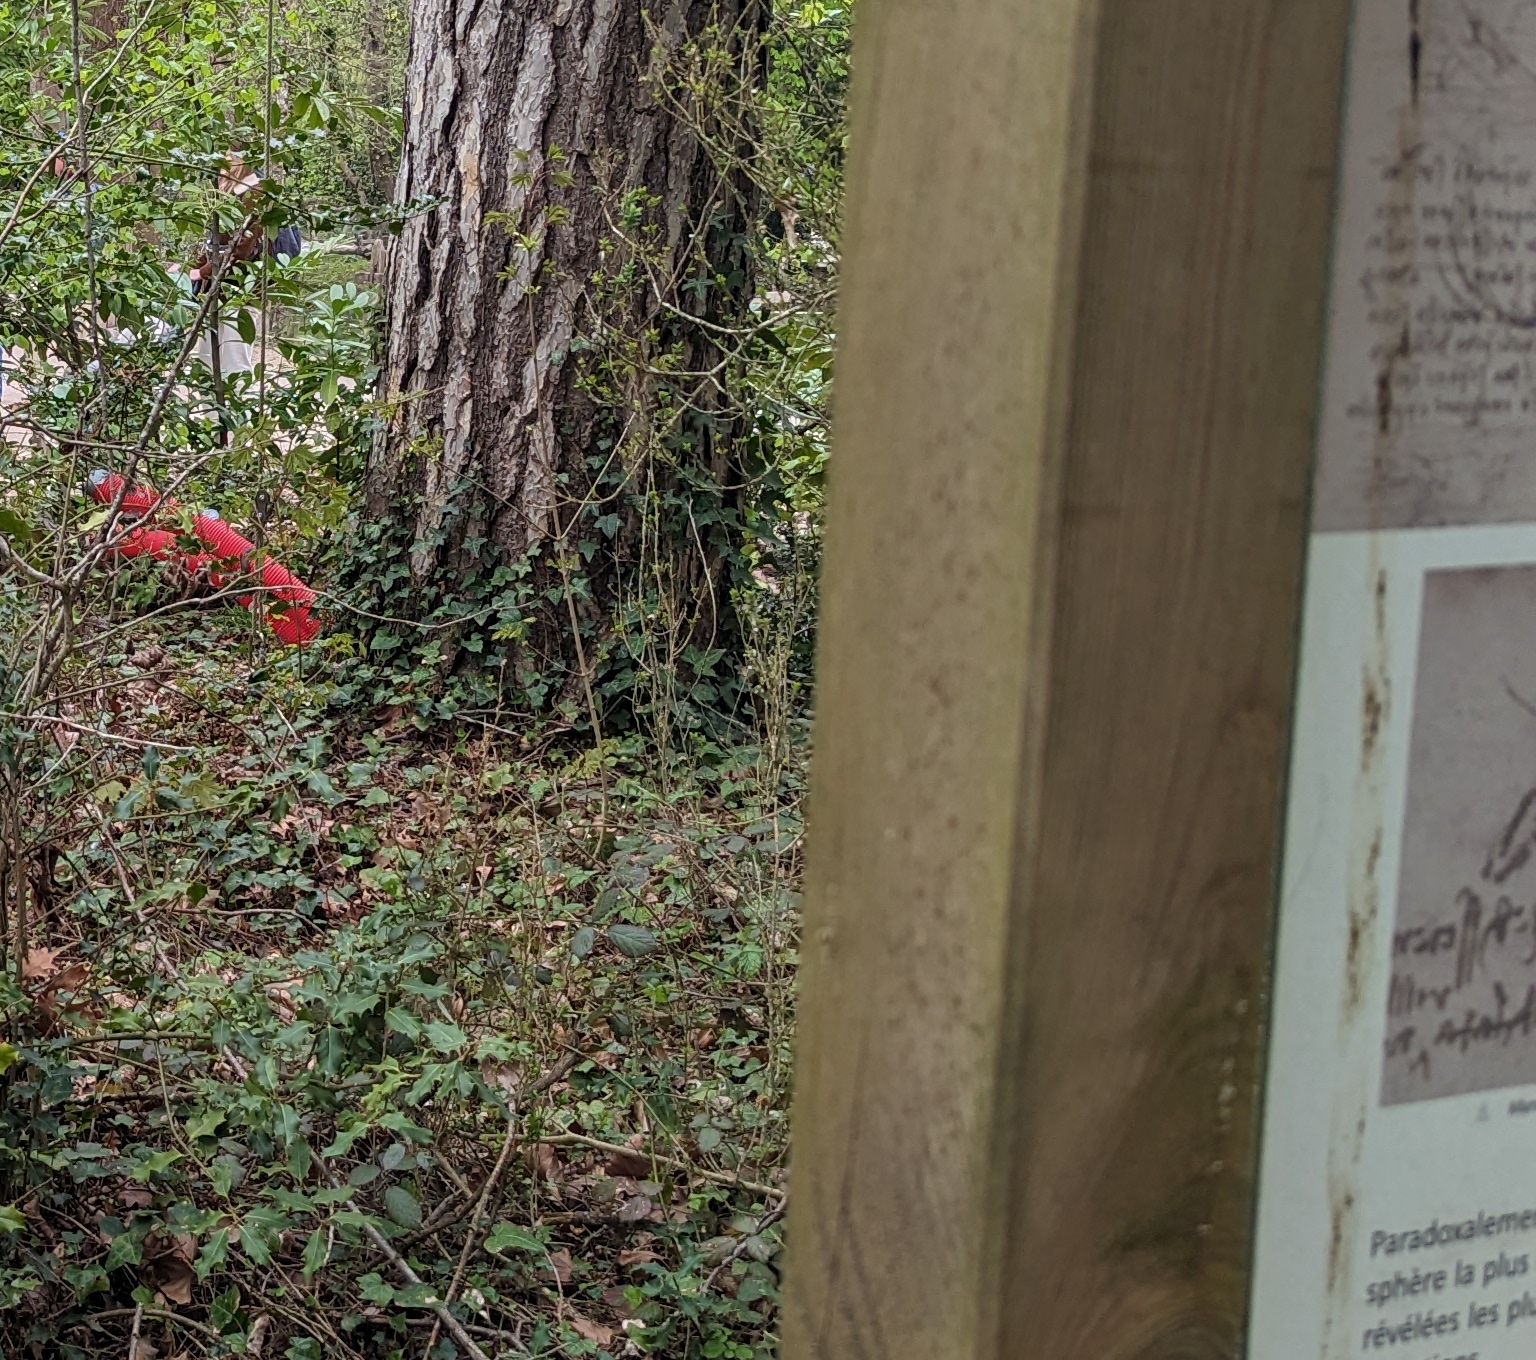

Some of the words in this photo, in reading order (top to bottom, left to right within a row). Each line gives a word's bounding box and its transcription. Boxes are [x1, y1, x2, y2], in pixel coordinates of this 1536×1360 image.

[1365, 1266, 1448, 1309] sphère
[1454, 1258, 1476, 1287] la
[1482, 1251, 1529, 1289] plus
[1361, 1308, 1461, 1350] révélées
[1468, 1301, 1500, 1329] les
